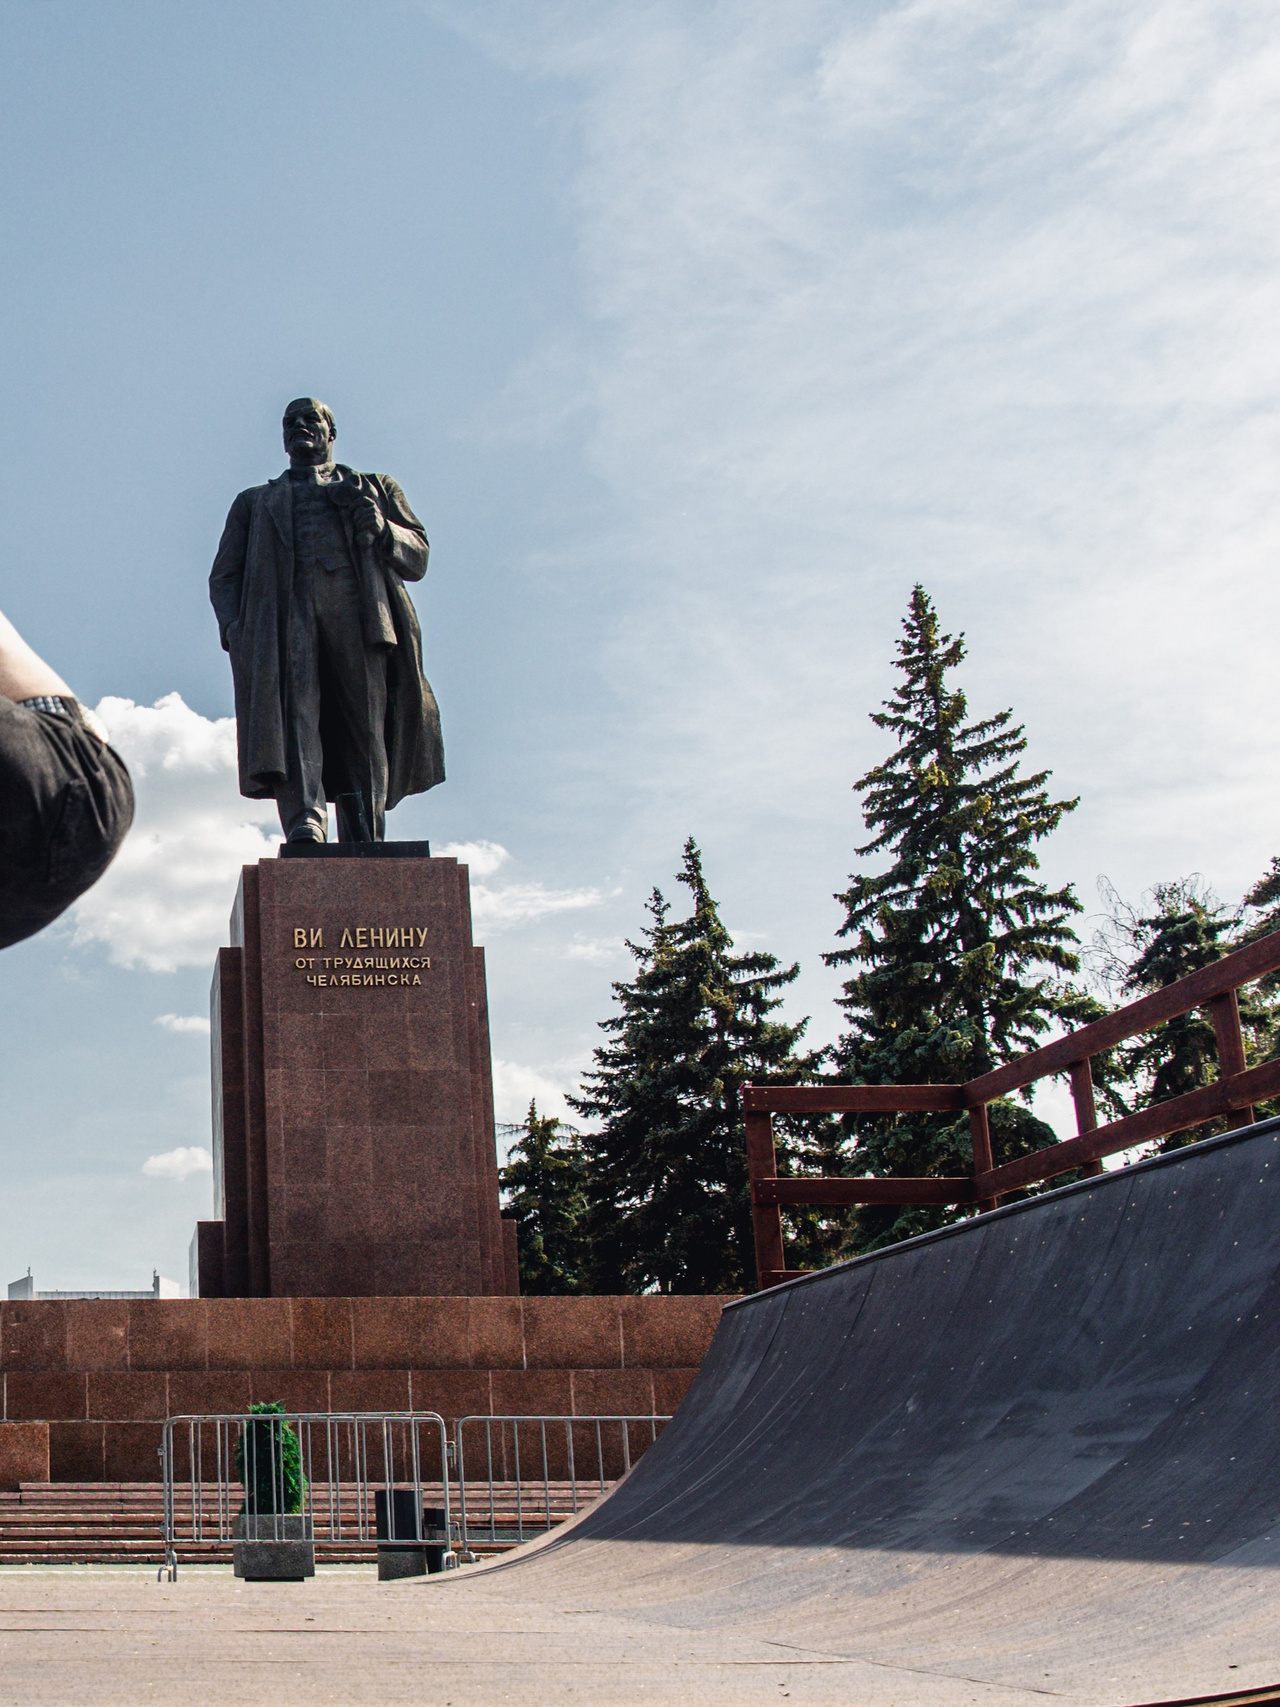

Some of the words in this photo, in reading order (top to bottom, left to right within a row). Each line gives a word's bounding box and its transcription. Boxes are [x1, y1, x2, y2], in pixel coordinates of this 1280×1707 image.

[340, 927, 428, 948] ЛЕНИНУ
[295, 957, 315, 969] ОТ
[323, 957, 431, 970] ТРУДЯЩИХСЯ
[306, 974, 422, 986] ЧЕЛЯБИНСКА
